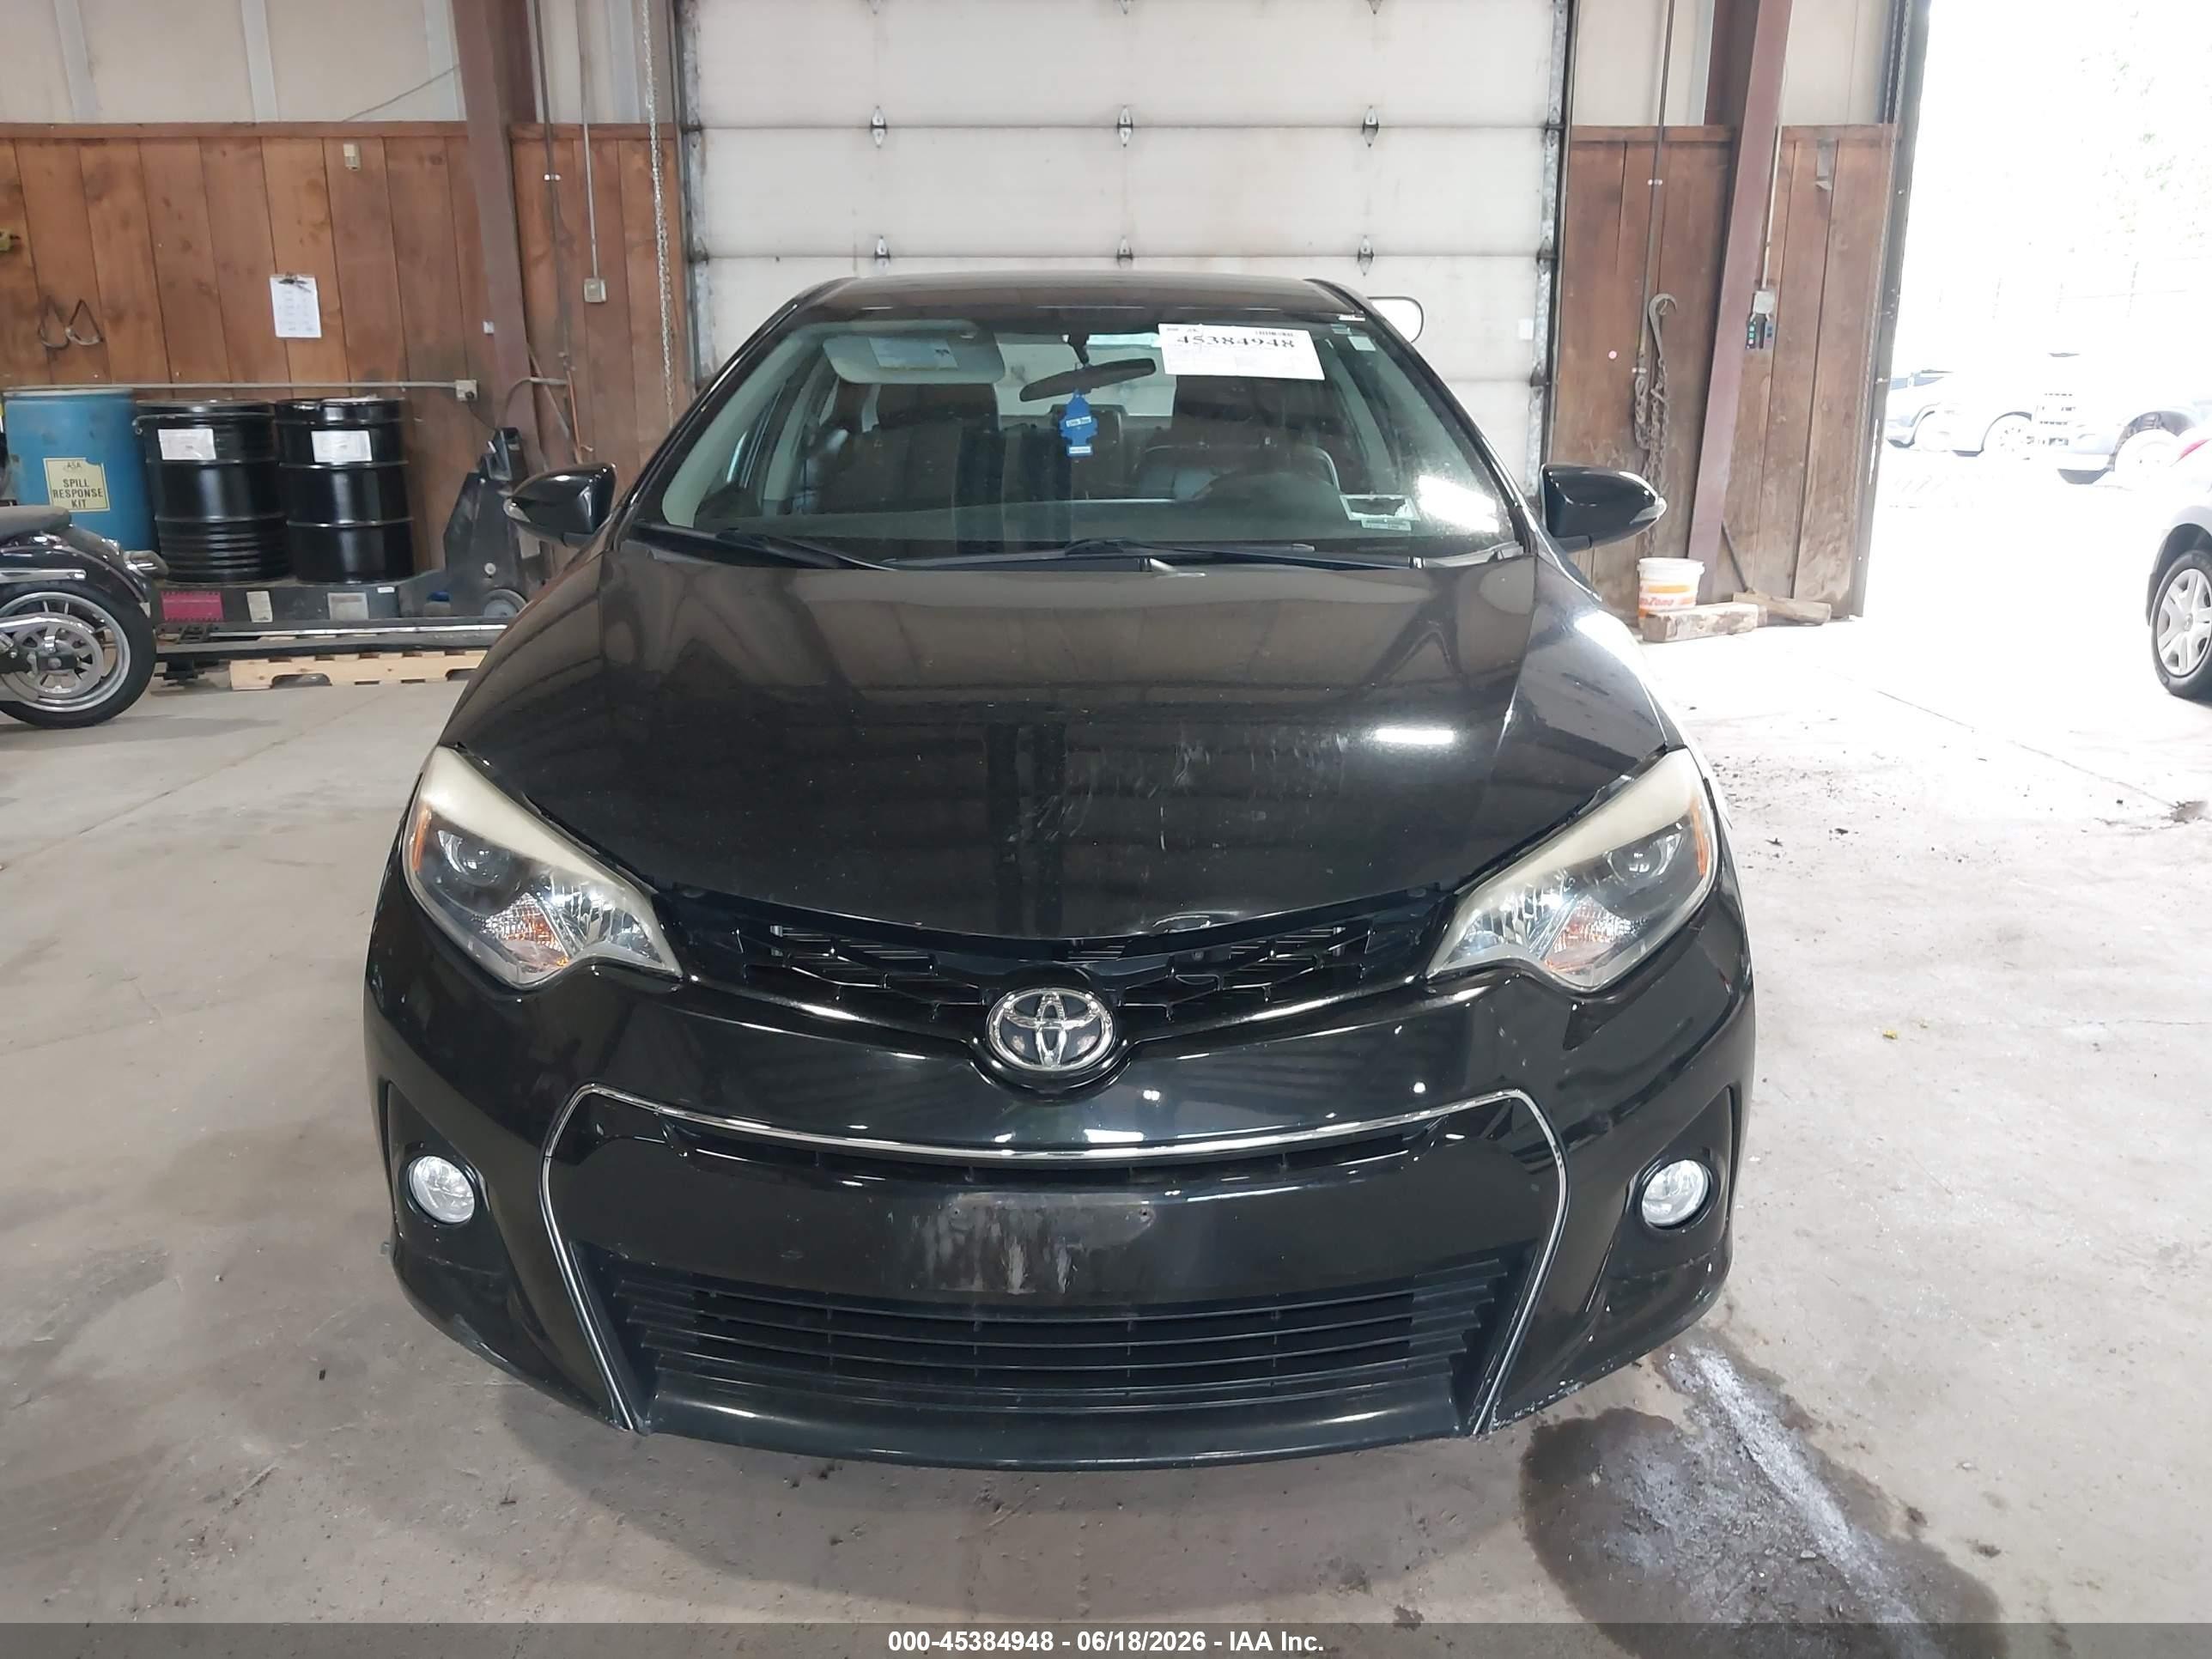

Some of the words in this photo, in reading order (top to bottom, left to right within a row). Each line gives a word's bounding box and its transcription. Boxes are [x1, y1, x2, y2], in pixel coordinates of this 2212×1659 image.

[63, 478, 89, 488] SPILL
[52, 488, 104, 498] RESPONSE
[71, 499, 87, 509] KIT
